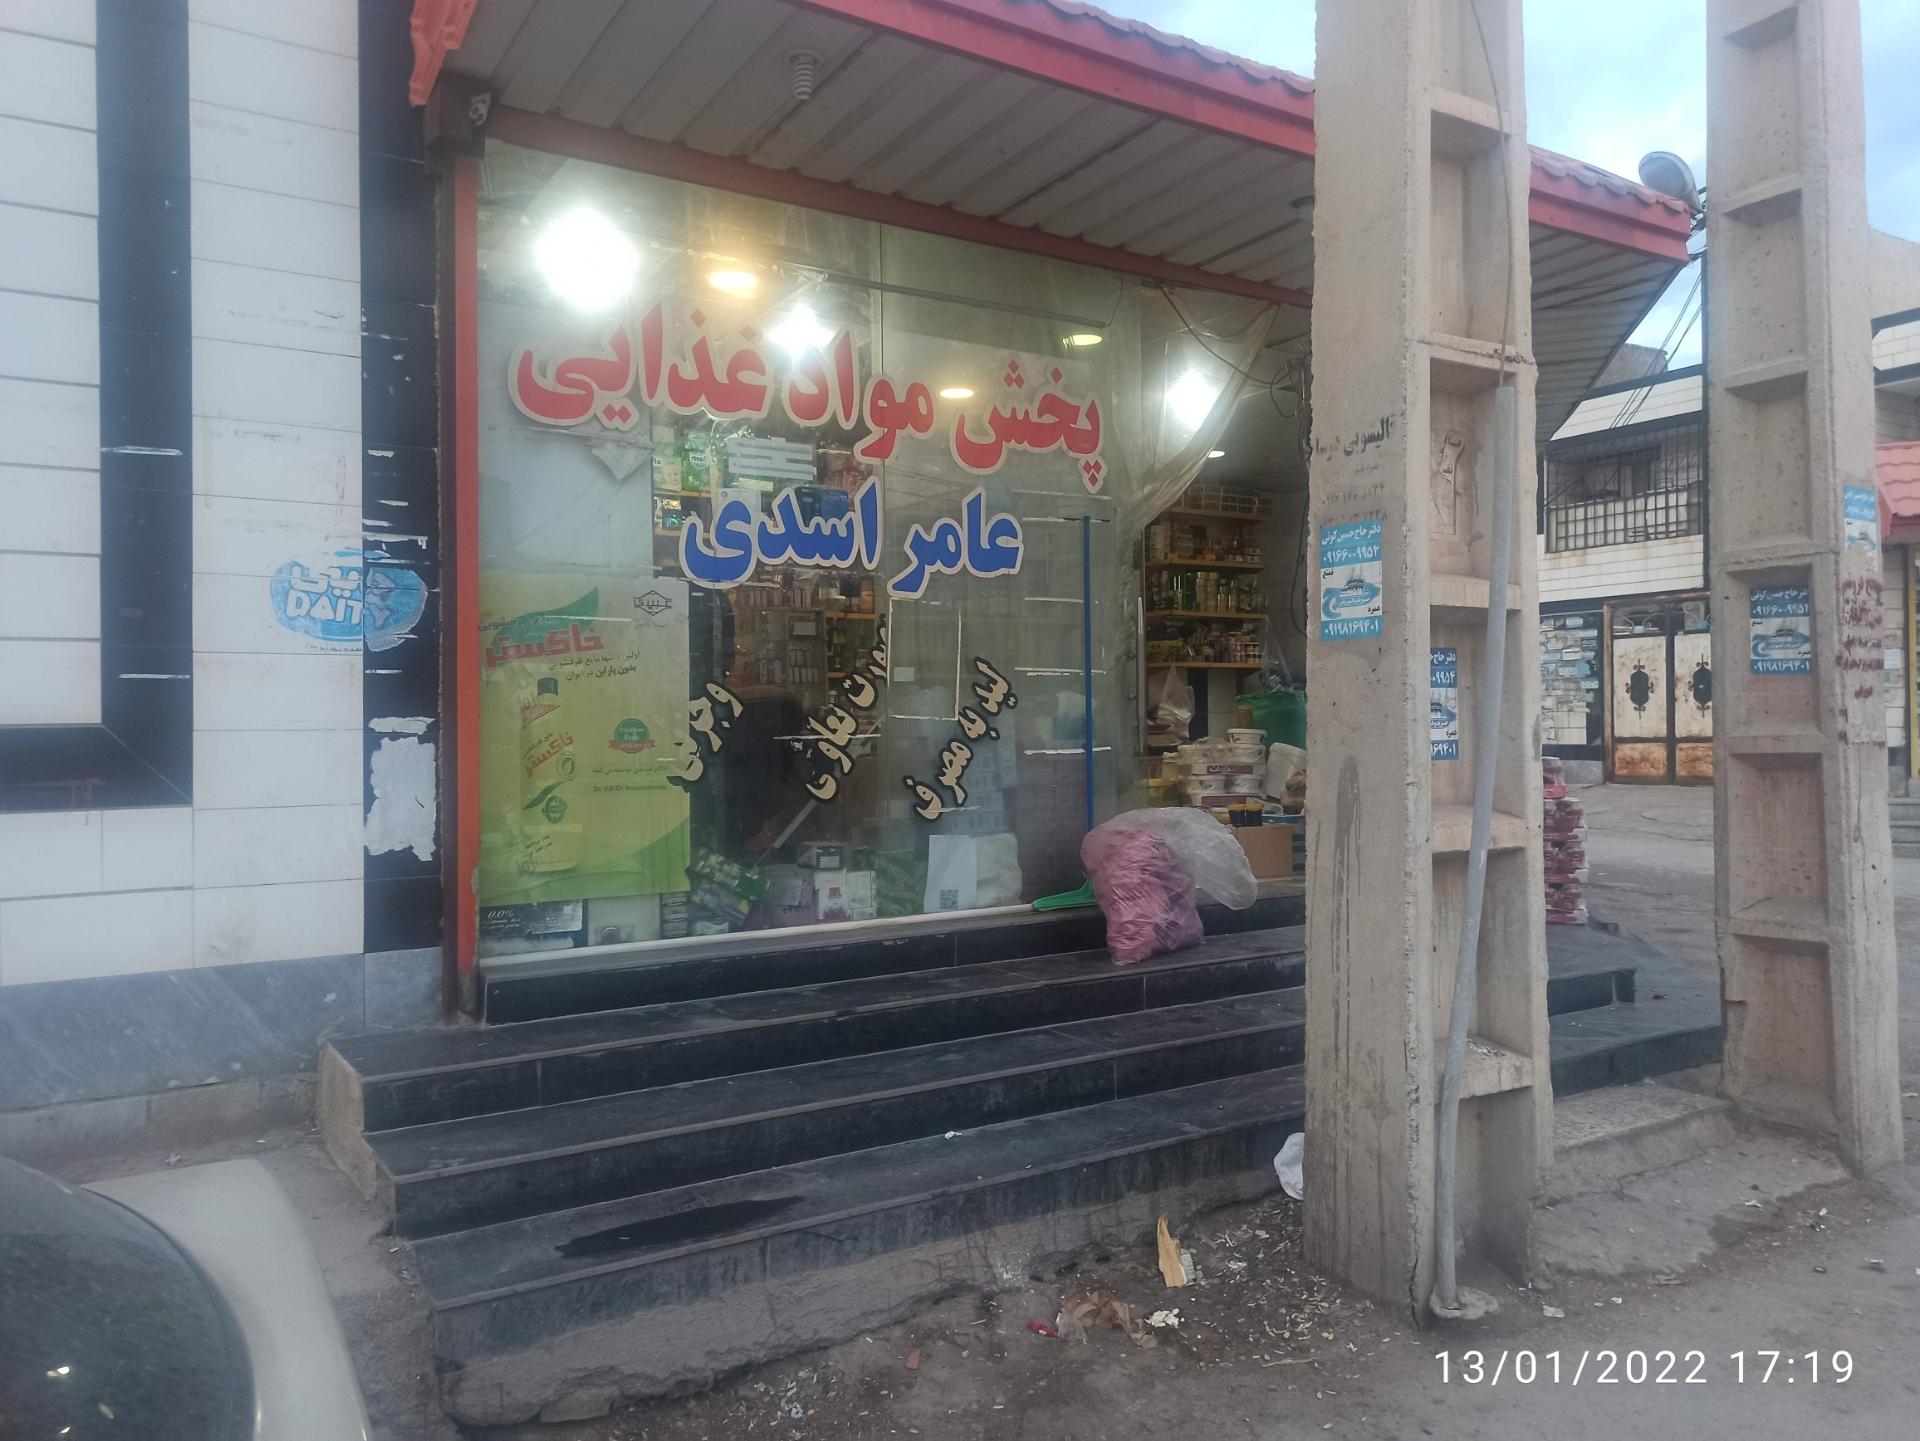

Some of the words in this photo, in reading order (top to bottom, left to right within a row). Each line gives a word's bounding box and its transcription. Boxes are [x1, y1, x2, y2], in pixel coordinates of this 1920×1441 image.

[509, 301, 774, 431] غذایی
[784, 328, 936, 464] مواد
[951, 356, 1109, 493] پخش
[680, 475, 886, 589] اسدی
[888, 486, 1024, 599] عامر
[286, 589, 393, 630] DAITY
